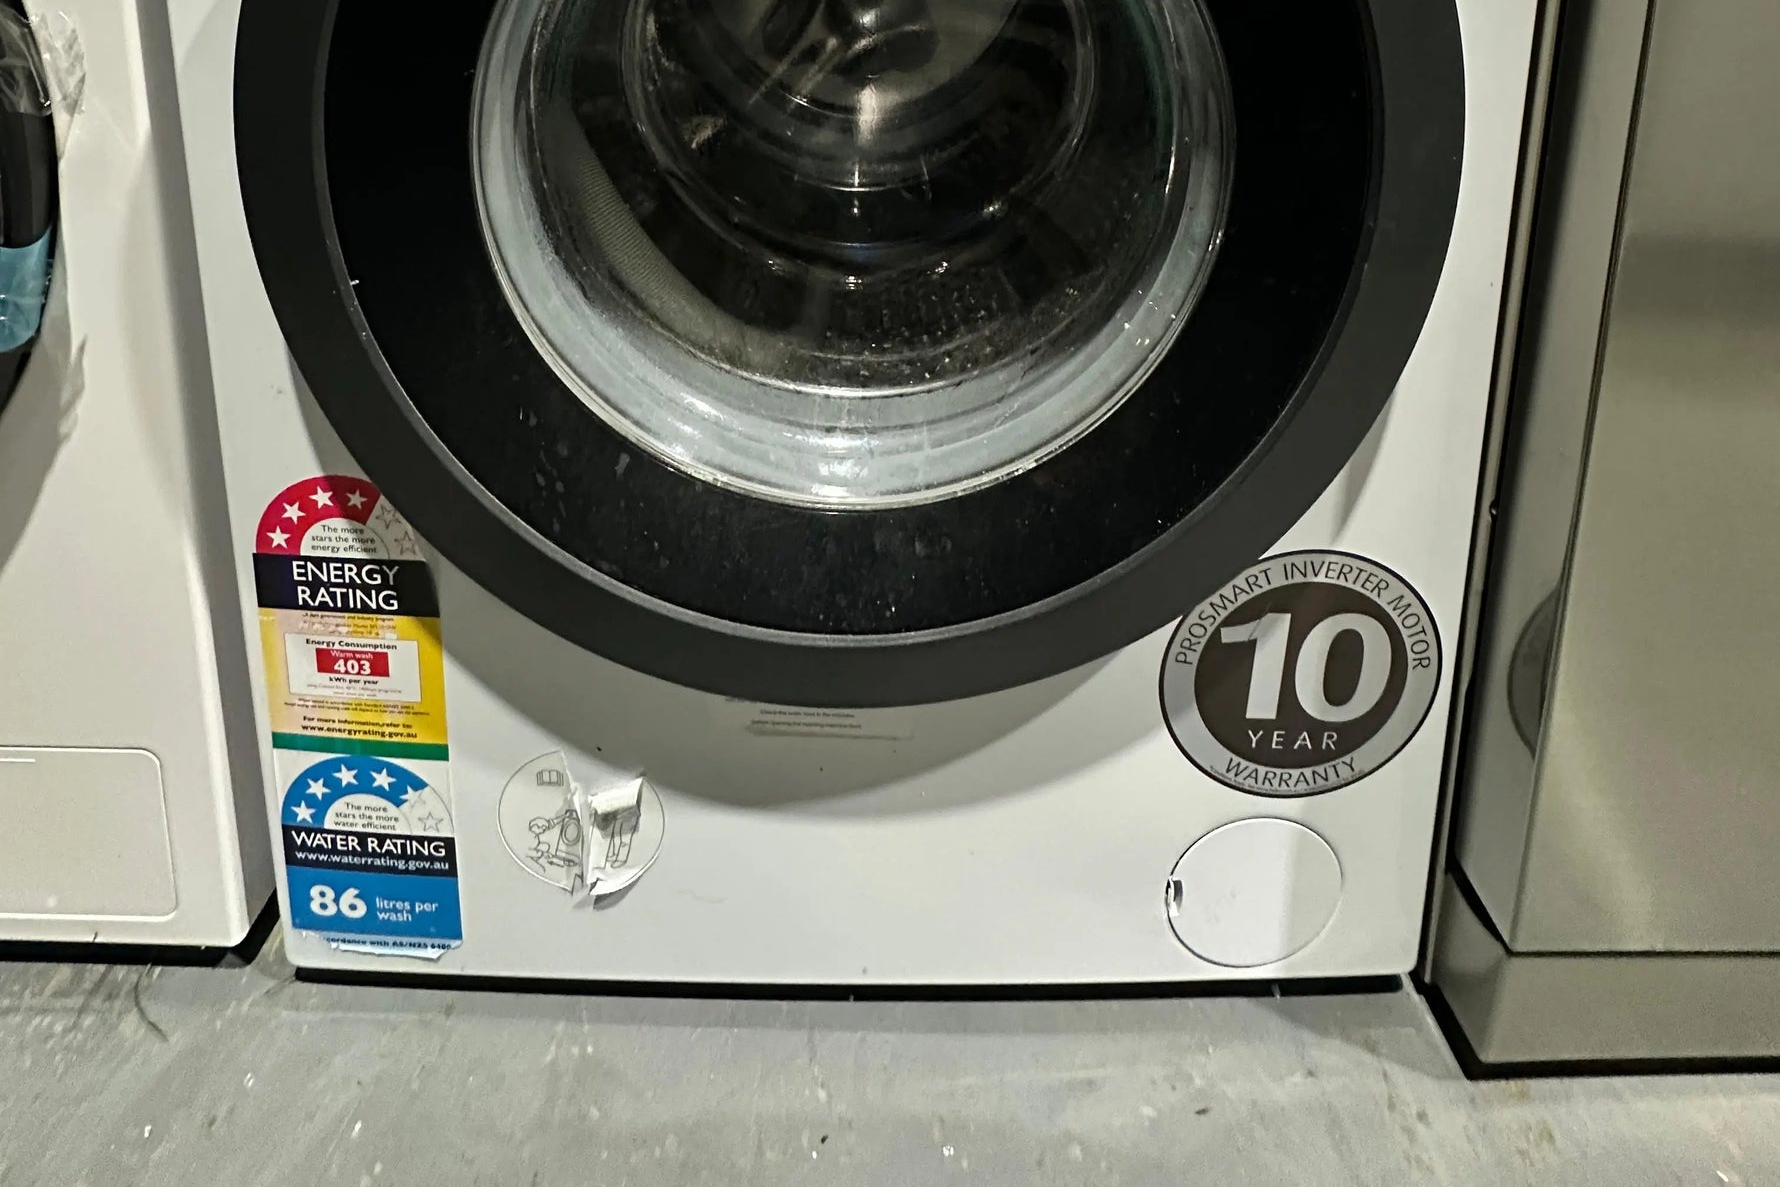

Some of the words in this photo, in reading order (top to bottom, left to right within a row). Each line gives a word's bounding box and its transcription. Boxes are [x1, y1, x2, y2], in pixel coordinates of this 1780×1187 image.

[321, 525, 338, 533] The
[311, 545, 340, 553] energy
[343, 545, 377, 553] efficient
[292, 560, 399, 586] ENERGY
[297, 586, 399, 610] RATING
[1175, 567, 1272, 665] PROSMART
[1283, 560, 1390, 598] INVERTER
[1387, 594, 1431, 670] MOTOR
[306, 638, 336, 647] Energy
[338, 640, 397, 651] Consumption
[330, 650, 353, 659] Warm
[355, 652, 373, 660] wash
[334, 659, 371, 675] 403
[1220, 612, 1392, 722] 10
[301, 724, 417, 738] www.energyrating.gov.au
[1247, 730, 1338, 750] YEAR
[1225, 757, 1356, 788] WARRANTY
[344, 802, 362, 811] The
[362, 821, 396, 831] efficient
[291, 830, 361, 851] WATER
[368, 838, 446, 857] RATING
[295, 851, 449, 871] www.waterrating.gov.au
[310, 884, 367, 918] 86
[376, 896, 410, 910] litres
[415, 901, 438, 913] per
[377, 911, 412, 922] wash
